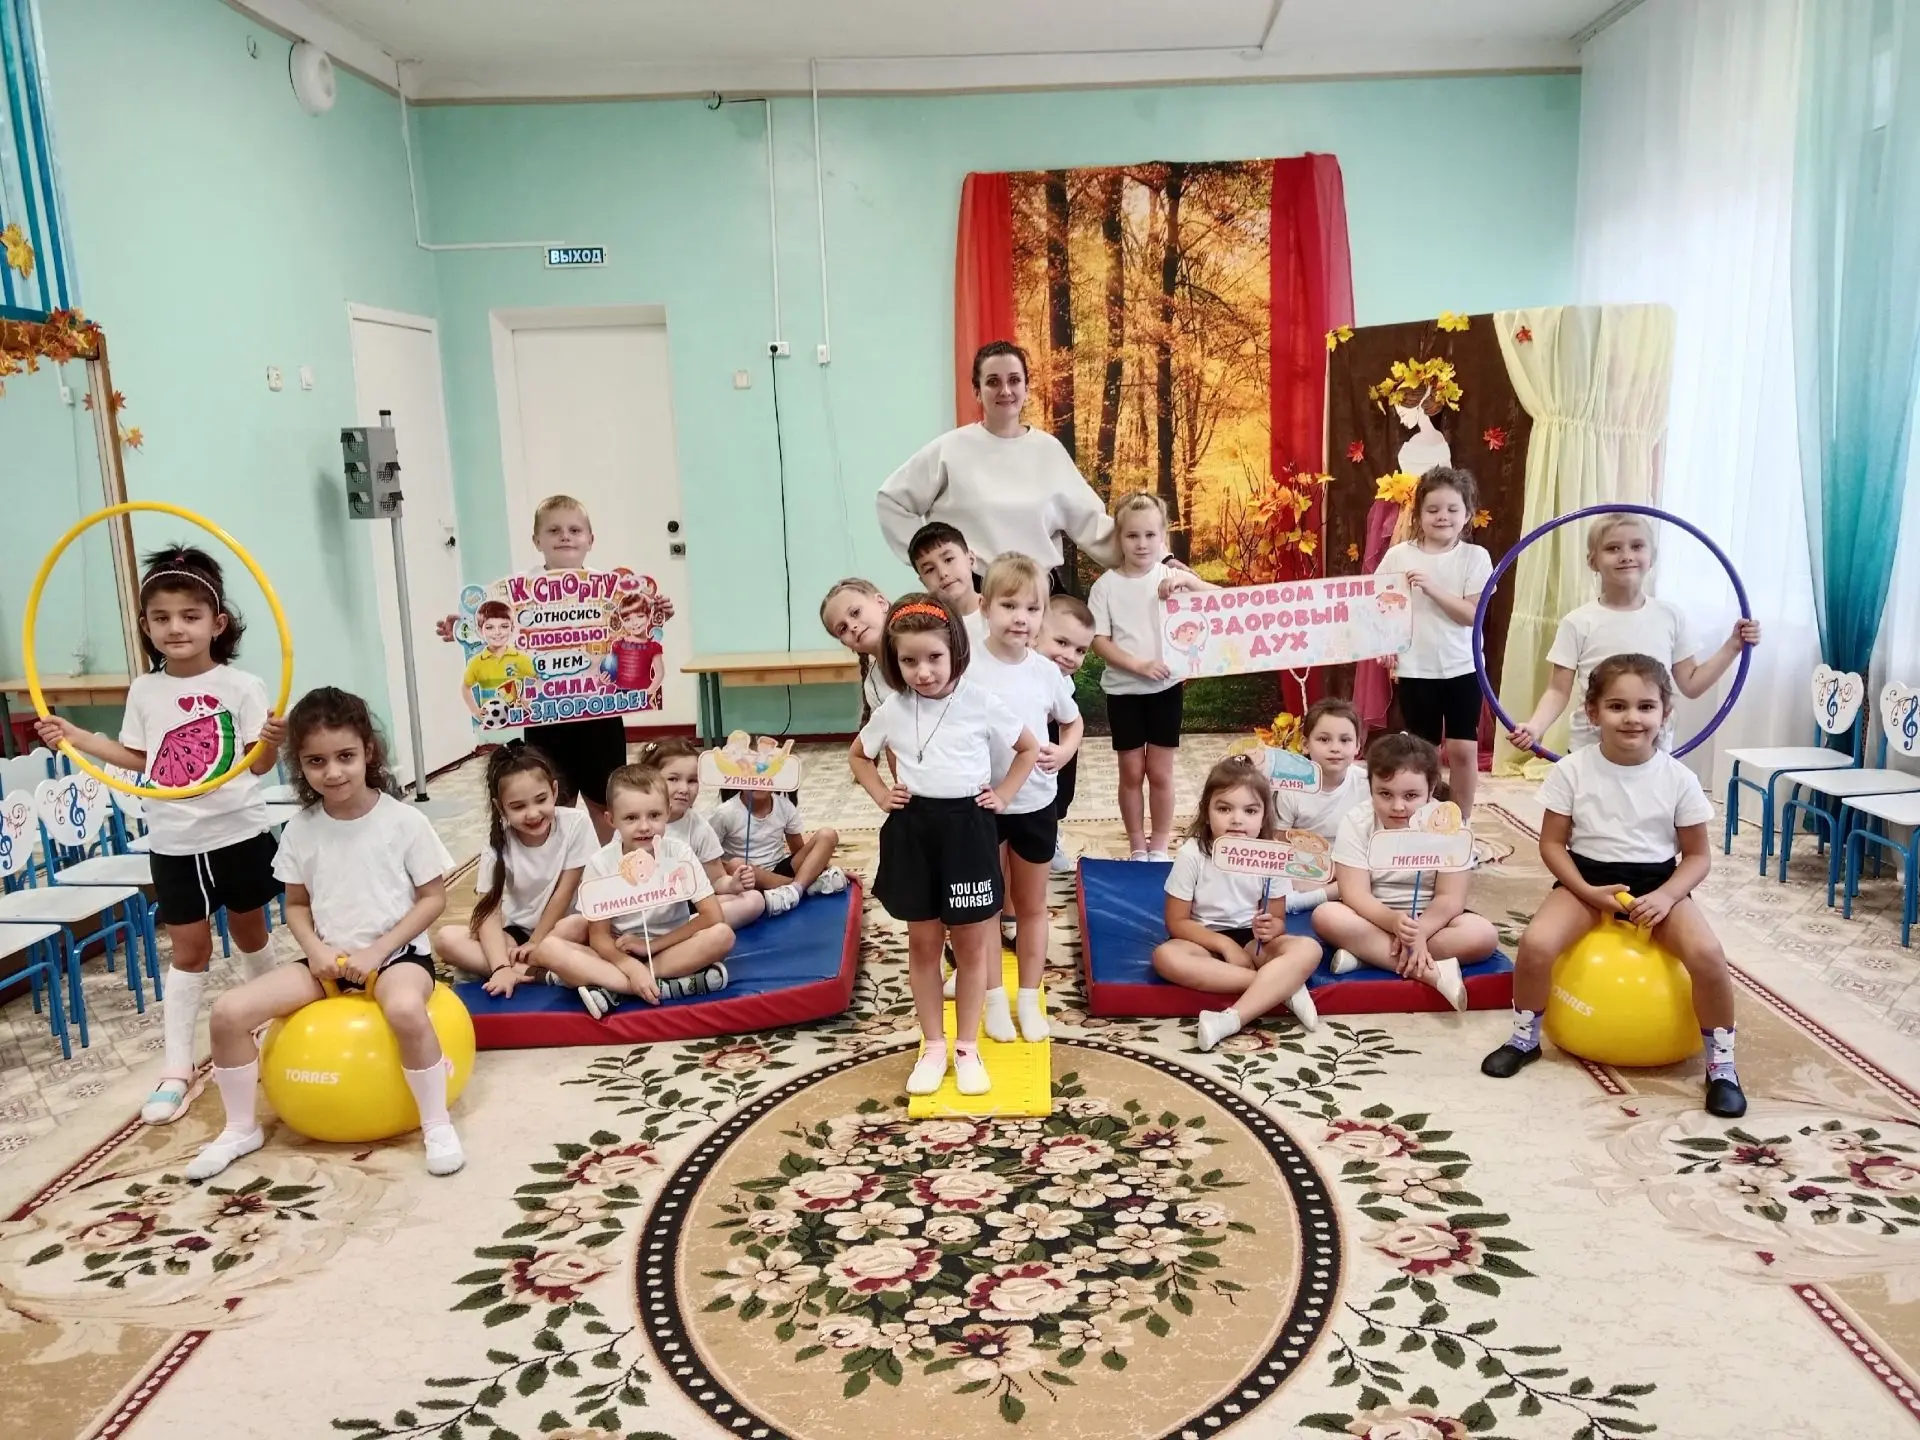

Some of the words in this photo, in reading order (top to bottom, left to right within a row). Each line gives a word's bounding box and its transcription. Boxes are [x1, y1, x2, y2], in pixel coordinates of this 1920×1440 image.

[550, 249, 603, 264] ВЫХОД
[508, 577, 529, 602] К
[534, 573, 618, 603] СПОРТУ
[1165, 598, 1180, 615] В
[1190, 585, 1314, 613] ЗДОРОВОМ
[1323, 580, 1376, 599] ТЕЛЕ
[1210, 601, 1349, 635] ЗДОРОВЫЙ
[517, 635, 527, 648] С
[530, 628, 608, 647] ЛЮБОВЬЮ!
[1250, 630, 1309, 658] ДУХ
[537, 659, 547, 671] В
[509, 708, 522, 723] И
[530, 691, 648, 722] ЗДОРОВЬЕ!
[723, 775, 774, 787] УЛЫБКА
[1279, 779, 1304, 789] ДНЯ
[1220, 846, 1294, 861] ЗДОРОВОЕ
[1391, 855, 1440, 866] ГИГИЕНА
[1227, 856, 1285, 870] ПИТАНИЕ
[950, 883, 970, 895] YOU
[972, 879, 991, 894] LOVE
[592, 887, 677, 913] ГИМНАСТИКА
[949, 891, 993, 908] YOURSELF
[1551, 984, 1596, 1017] ORRES
[284, 1068, 342, 1086] TORRES
